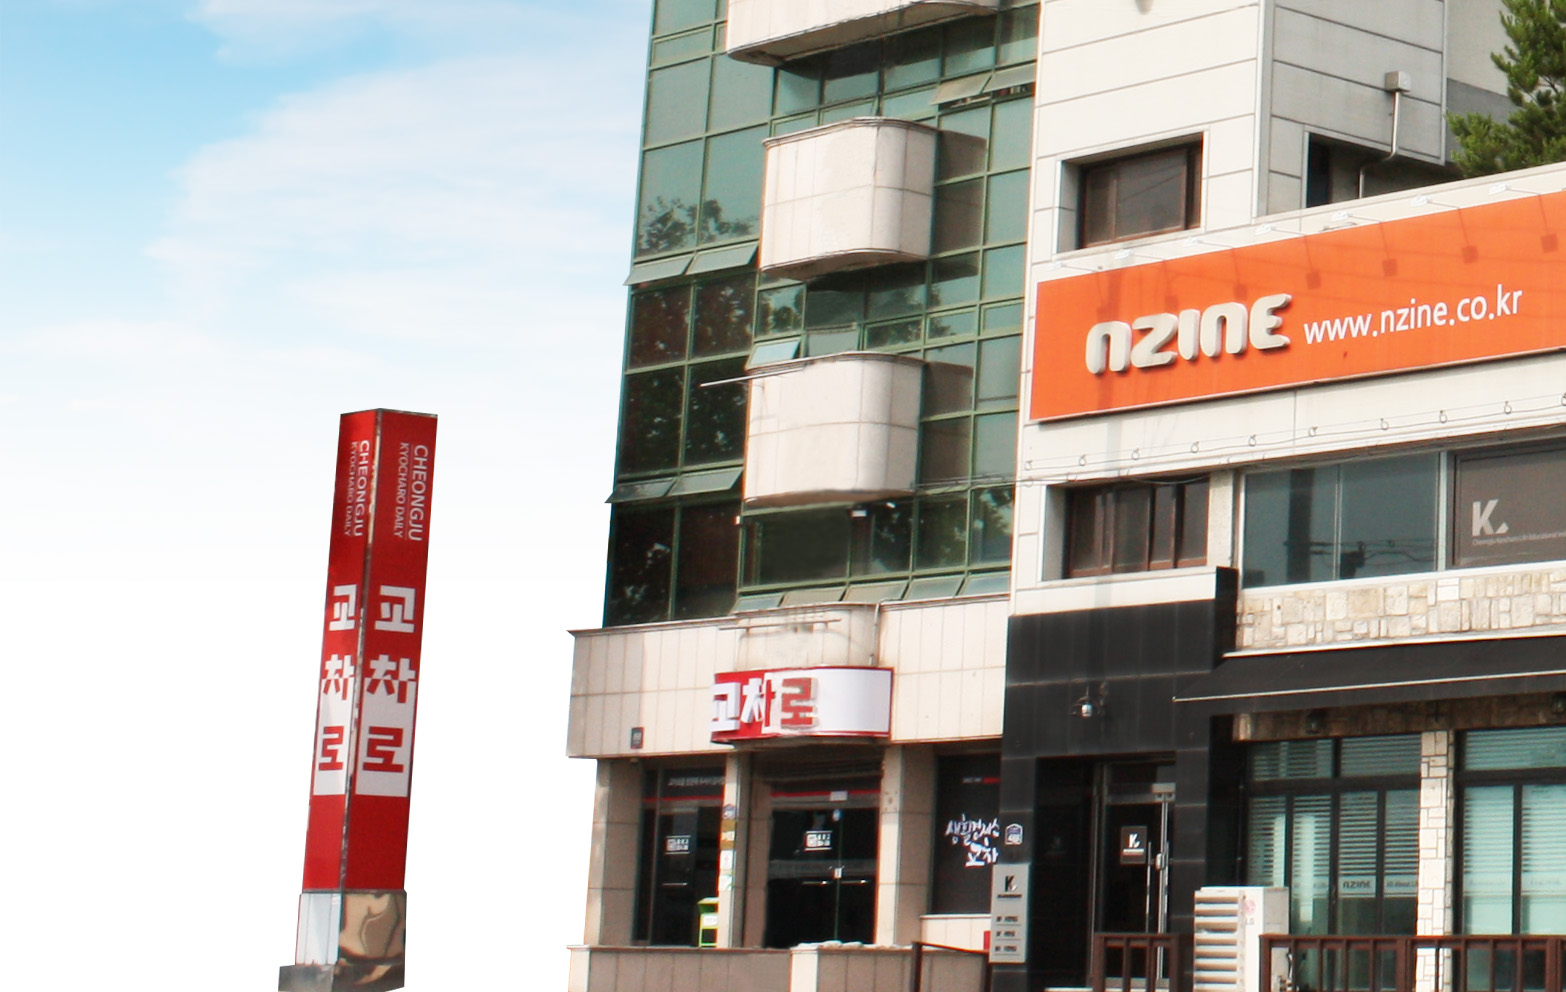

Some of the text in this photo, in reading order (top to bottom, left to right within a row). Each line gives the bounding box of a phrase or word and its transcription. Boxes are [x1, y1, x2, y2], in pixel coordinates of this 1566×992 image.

[1303, 284, 1523, 344] www.nzine.co.kr
[353, 439, 370, 537] CHEONGJU
[393, 442, 409, 538] KYOCHARO DAILY
[408, 444, 429, 542] CHEONGJU
[318, 584, 357, 772] 교차로
[362, 585, 417, 774] 교차로
[710, 676, 819, 733] 교차로
